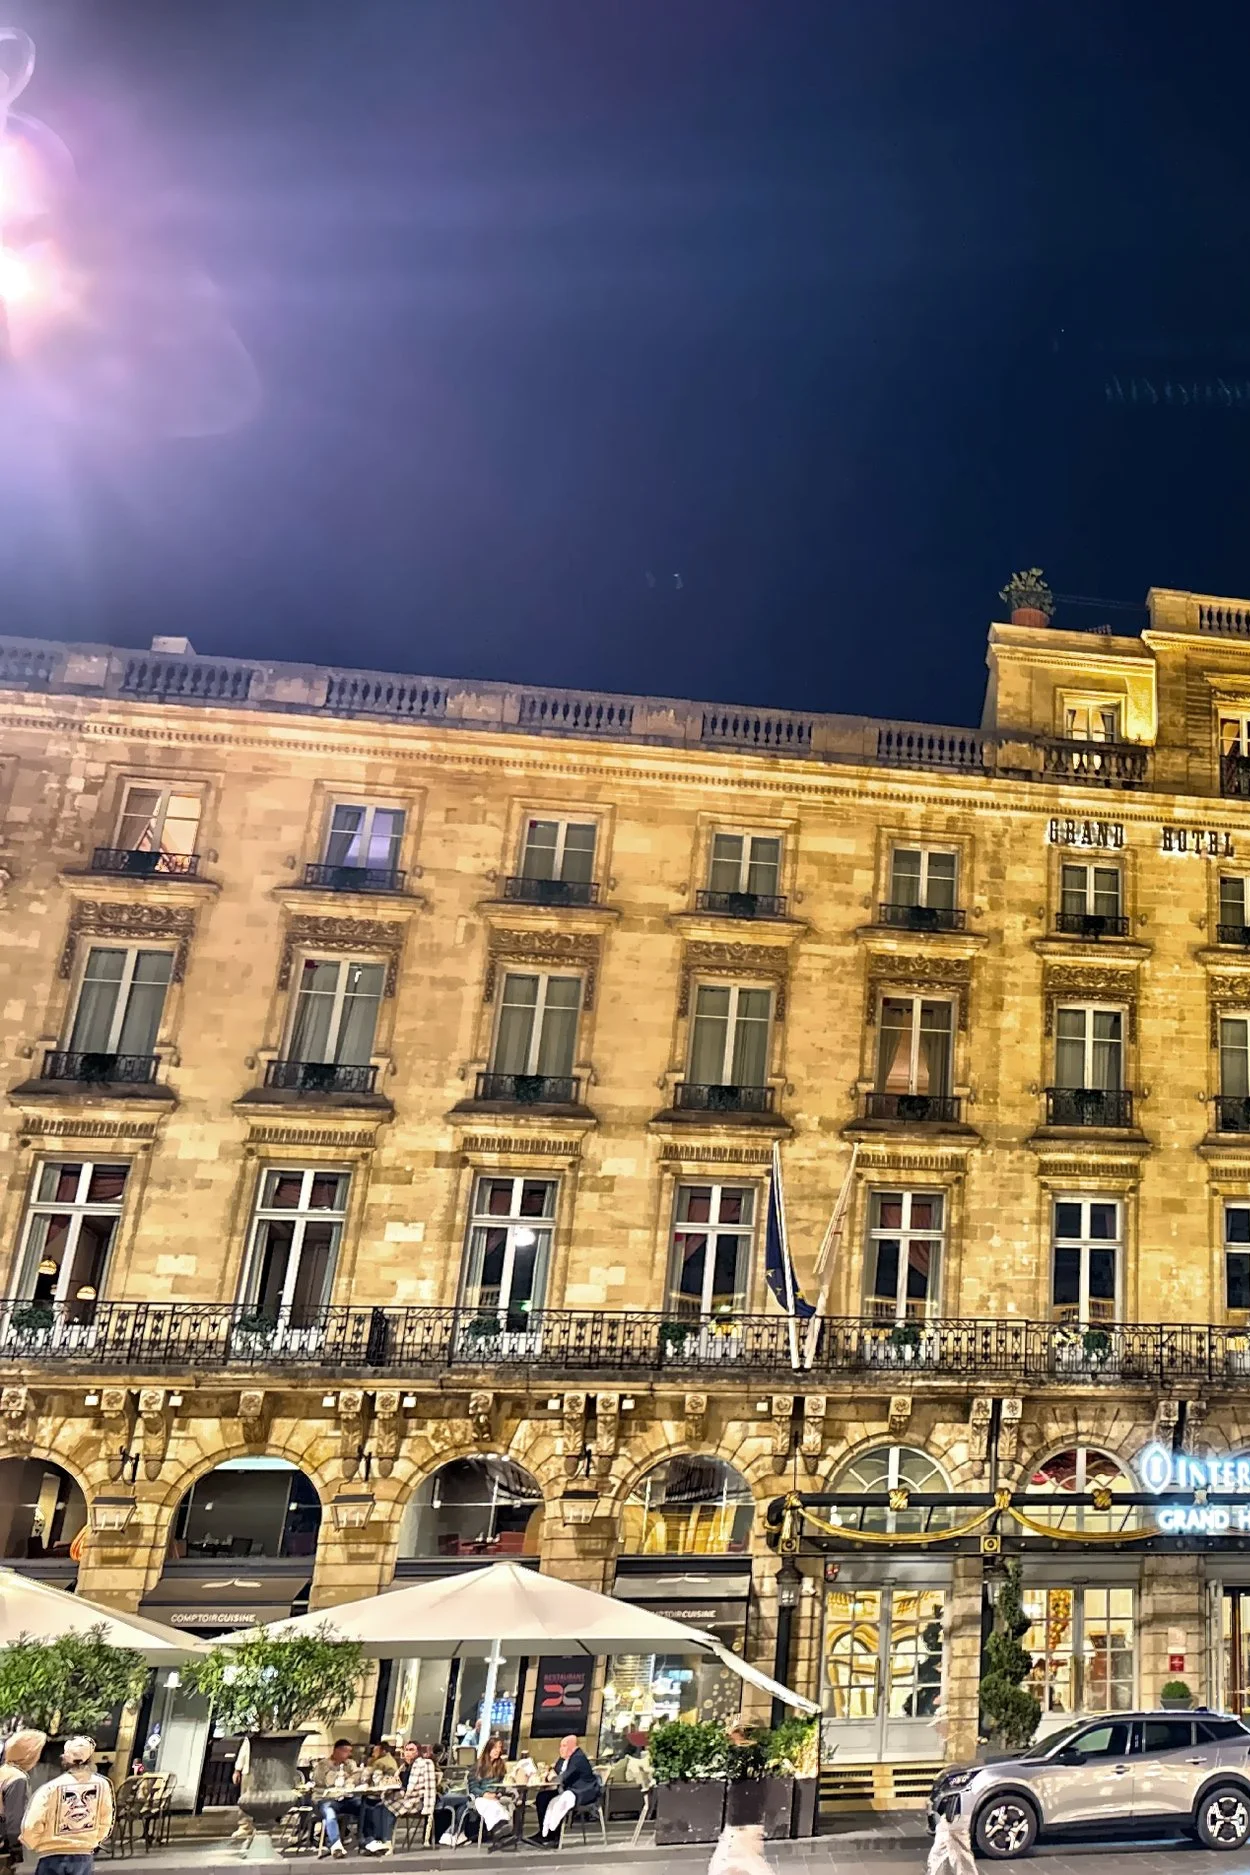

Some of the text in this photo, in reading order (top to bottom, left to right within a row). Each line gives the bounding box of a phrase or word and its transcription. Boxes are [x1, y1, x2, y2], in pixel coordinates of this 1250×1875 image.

[1050, 818, 1124, 848] GRAND
[1163, 826, 1234, 857] HOTEL
[1158, 1508, 1230, 1530] GRAND
